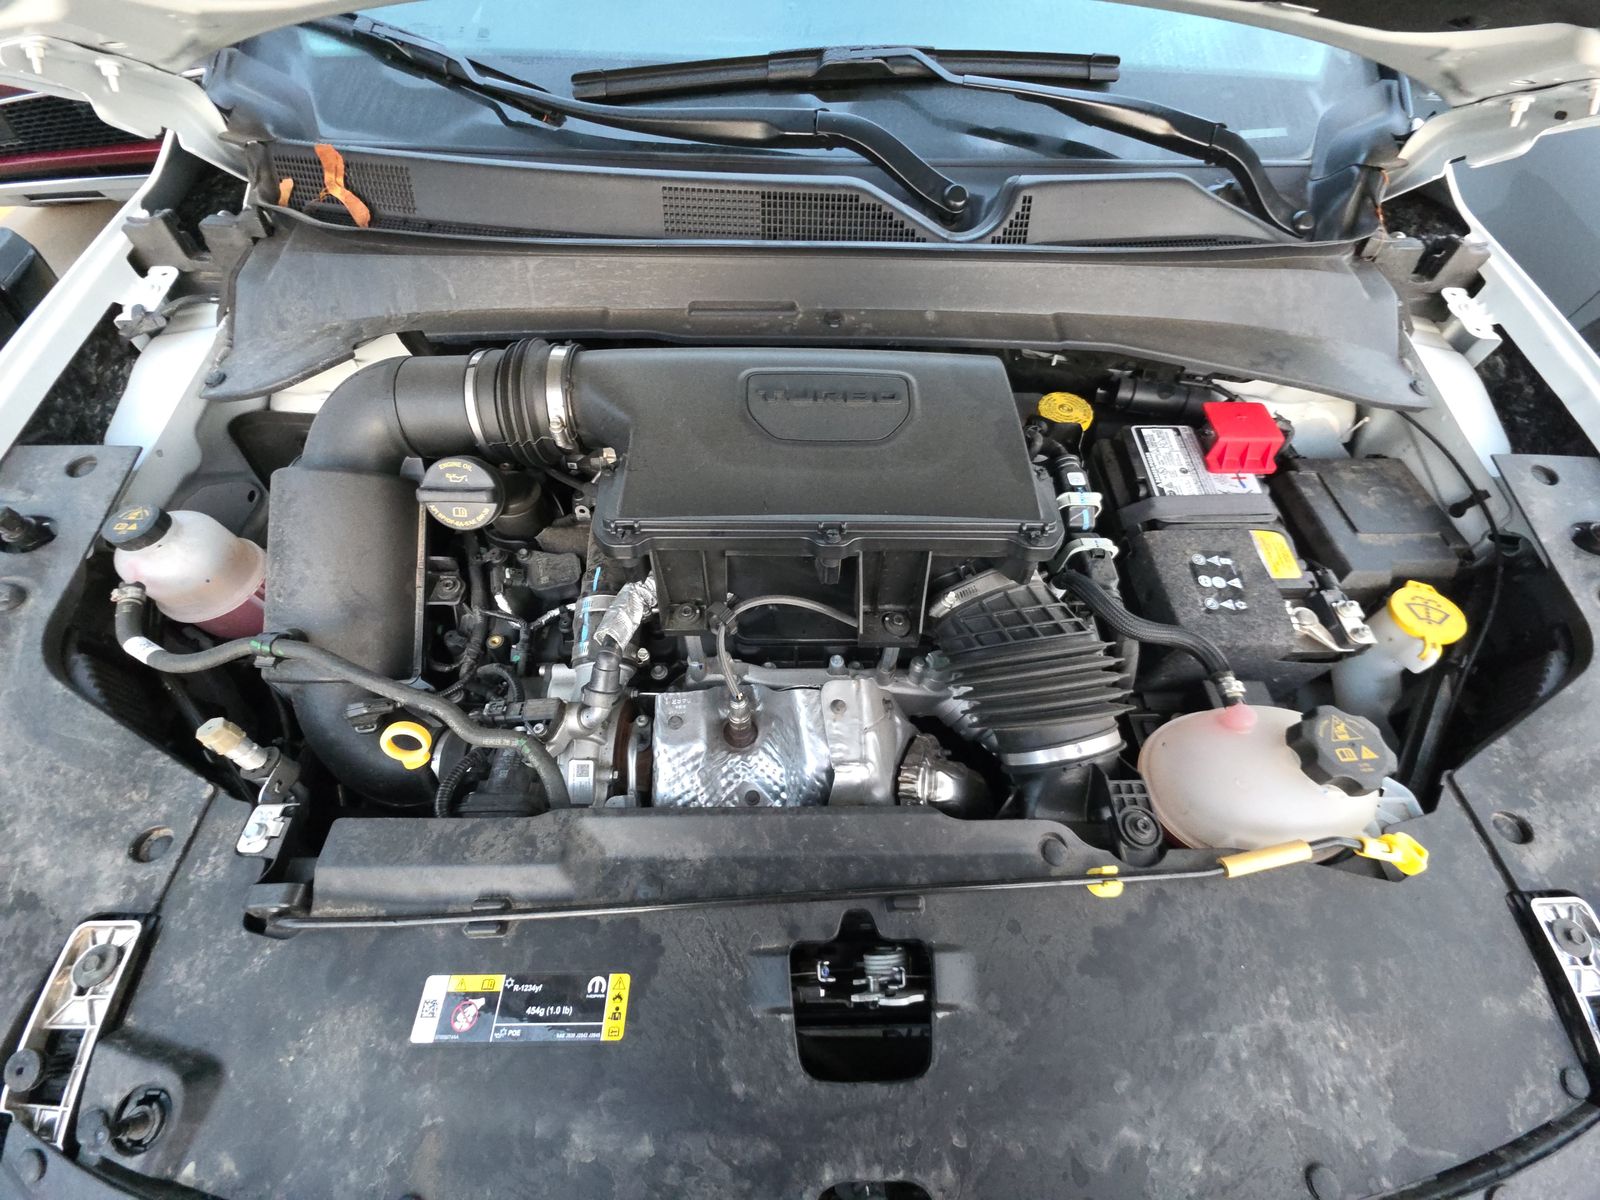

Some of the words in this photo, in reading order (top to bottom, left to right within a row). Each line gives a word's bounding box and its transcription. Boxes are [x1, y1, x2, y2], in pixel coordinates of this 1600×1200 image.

[462, 463, 473, 472] OIL
[513, 984, 543, 993] R-1234yf
[525, 1006, 545, 1017] 454g
[546, 1006, 561, 1016] (1.0
[562, 1006, 573, 1016] lb)
